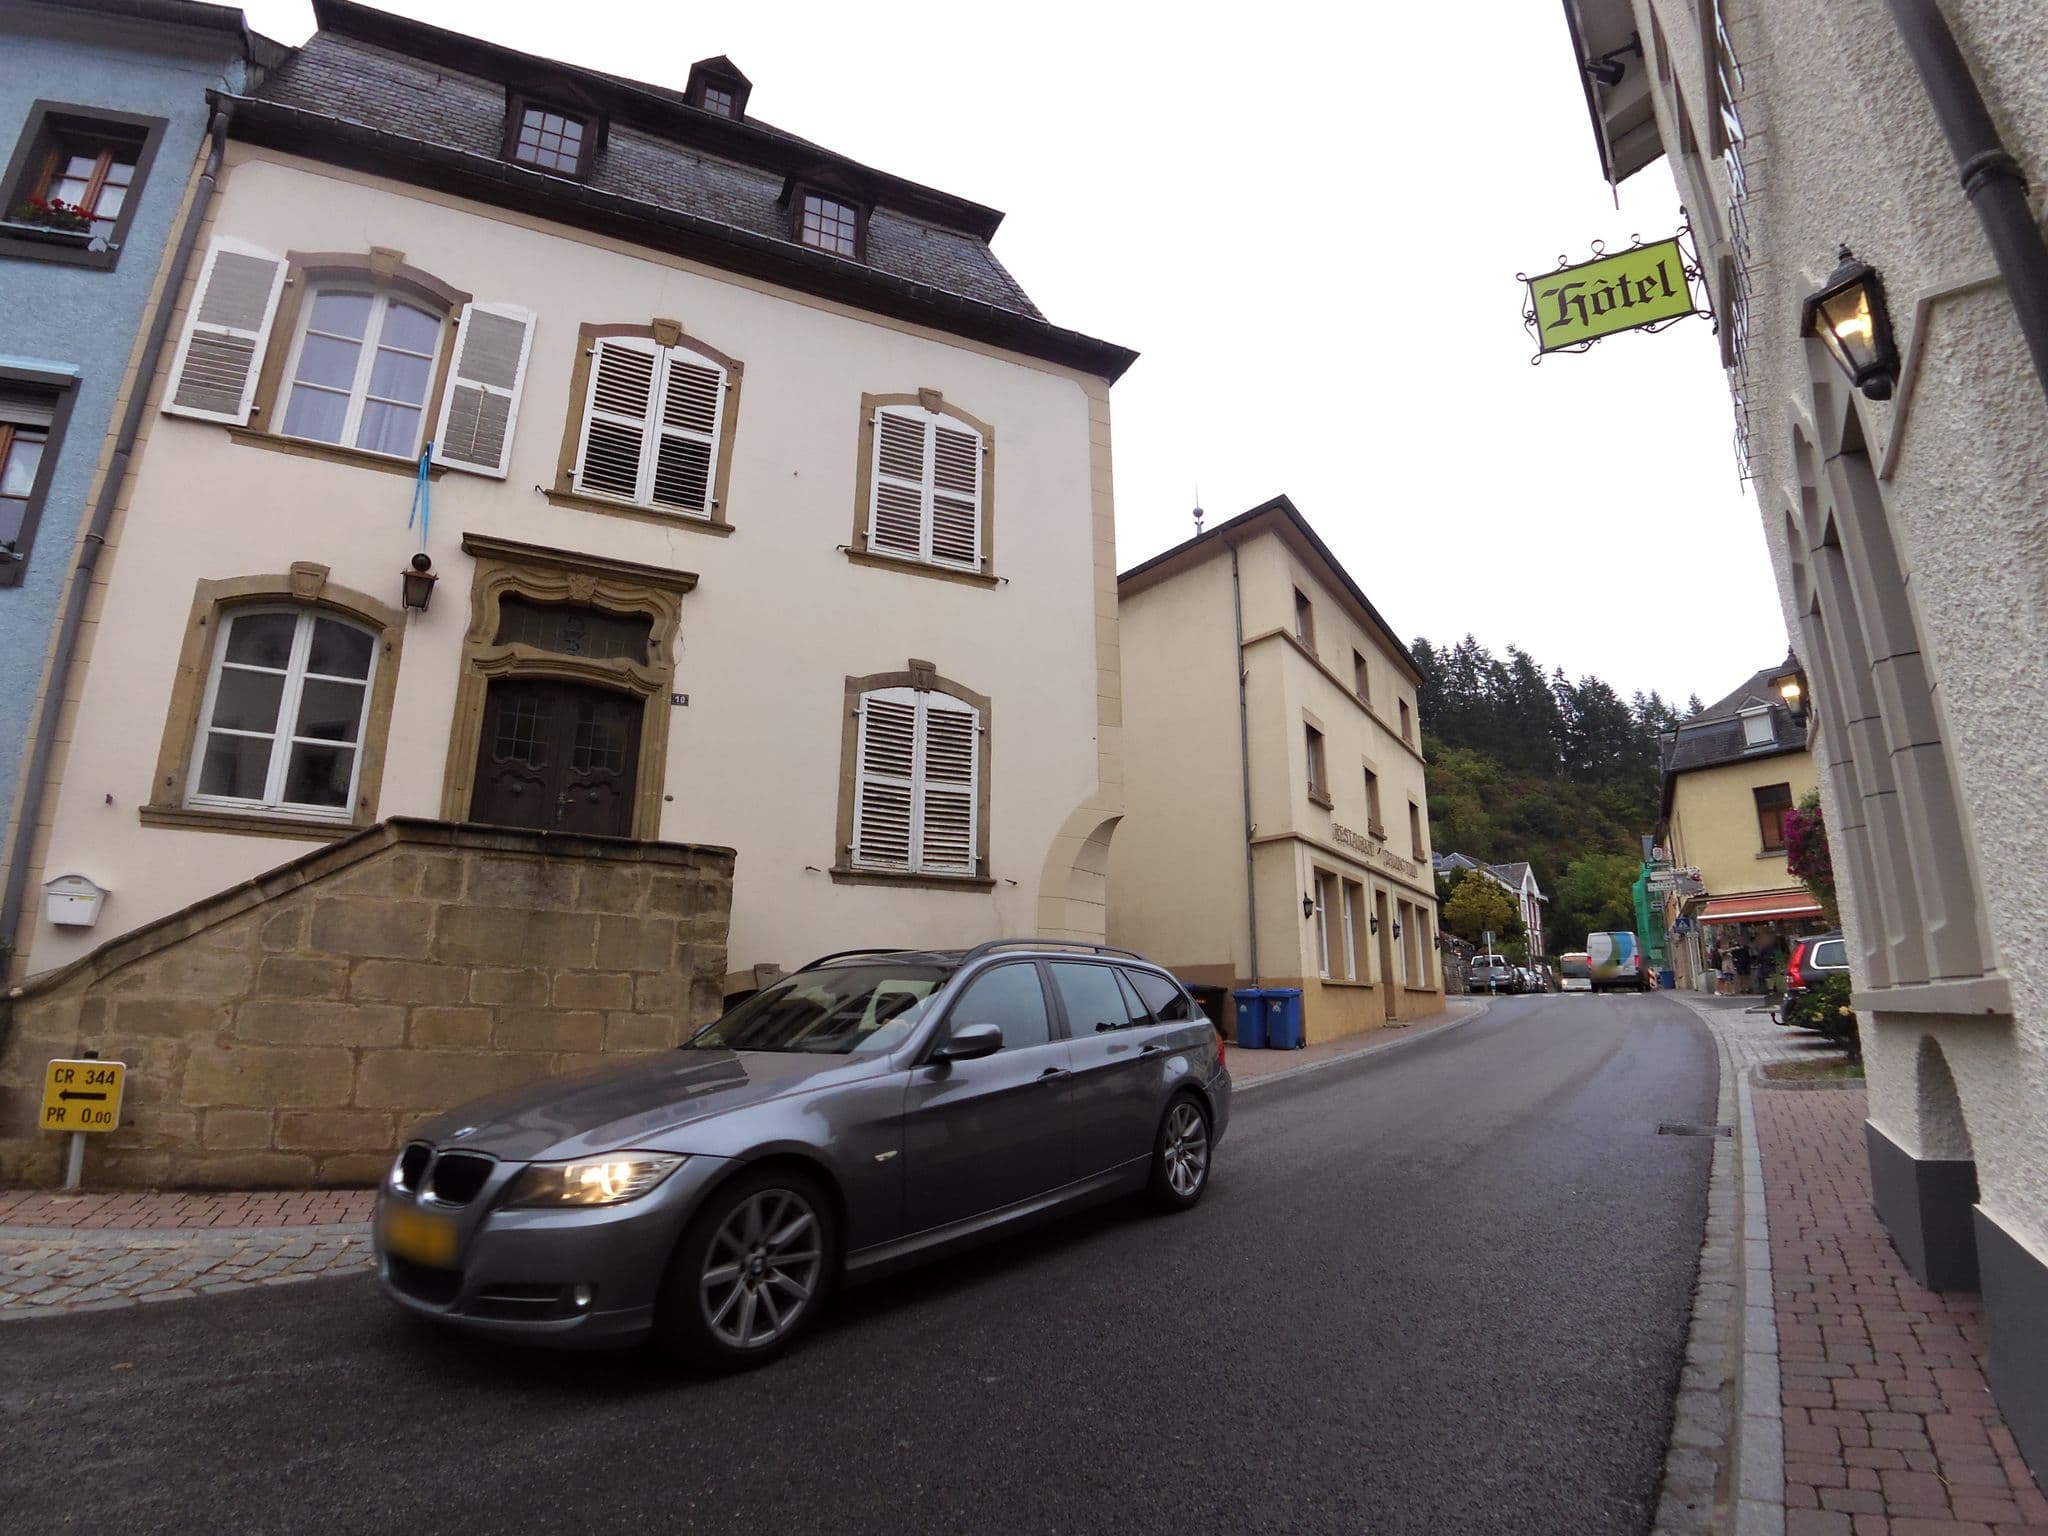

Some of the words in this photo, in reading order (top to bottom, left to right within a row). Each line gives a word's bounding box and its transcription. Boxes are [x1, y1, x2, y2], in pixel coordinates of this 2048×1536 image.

[1541, 259, 1678, 331] Hôtel
[674, 695, 686, 704] 10
[54, 1068, 75, 1083] CR
[85, 1070, 115, 1085] 344
[46, 1106, 66, 1122] PR
[81, 1108, 112, 1124] 0.00
